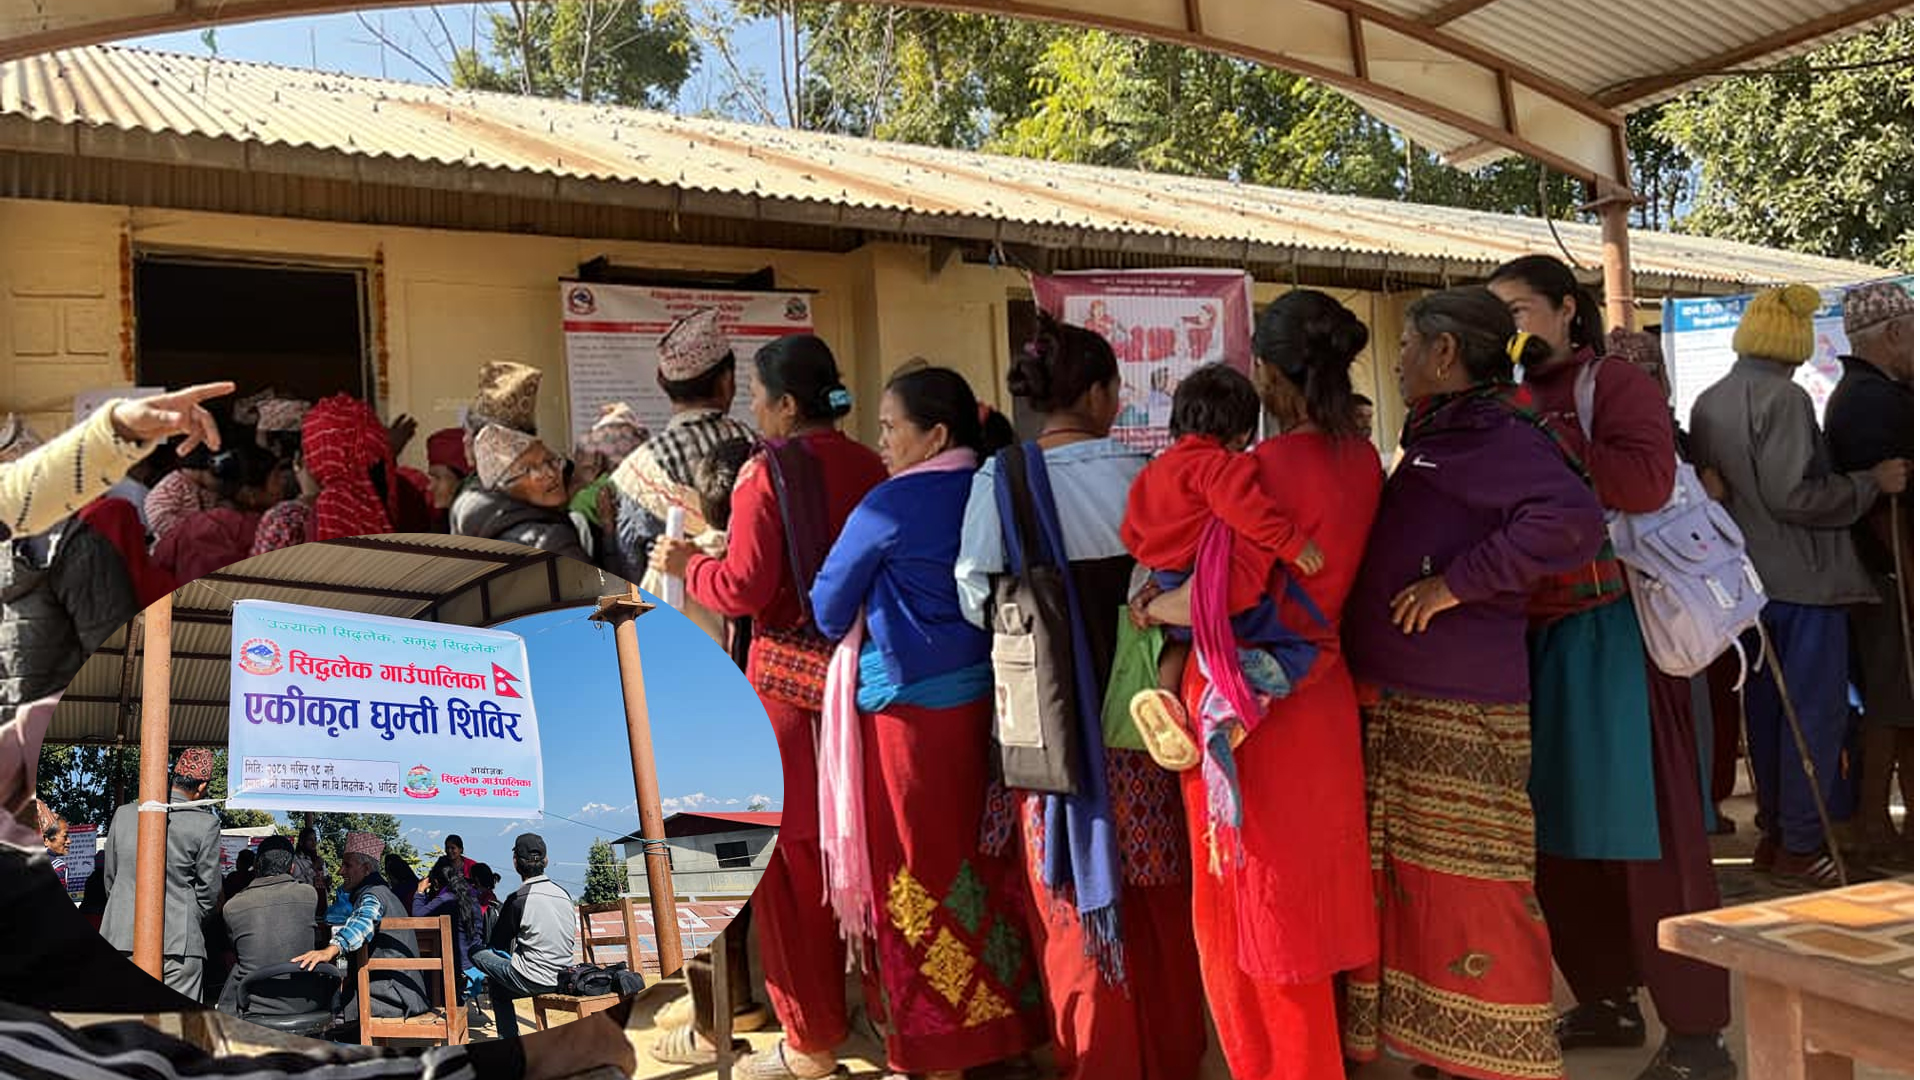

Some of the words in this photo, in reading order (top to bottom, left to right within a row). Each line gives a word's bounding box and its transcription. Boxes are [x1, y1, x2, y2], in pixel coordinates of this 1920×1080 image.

[289, 650, 373, 682] सिद्धलेक
[380, 662, 486, 691] गाउँपालिका
[244, 685, 360, 738] एकीकृत
[370, 695, 438, 741] घुम्ती
[447, 697, 522, 742] शिविर
